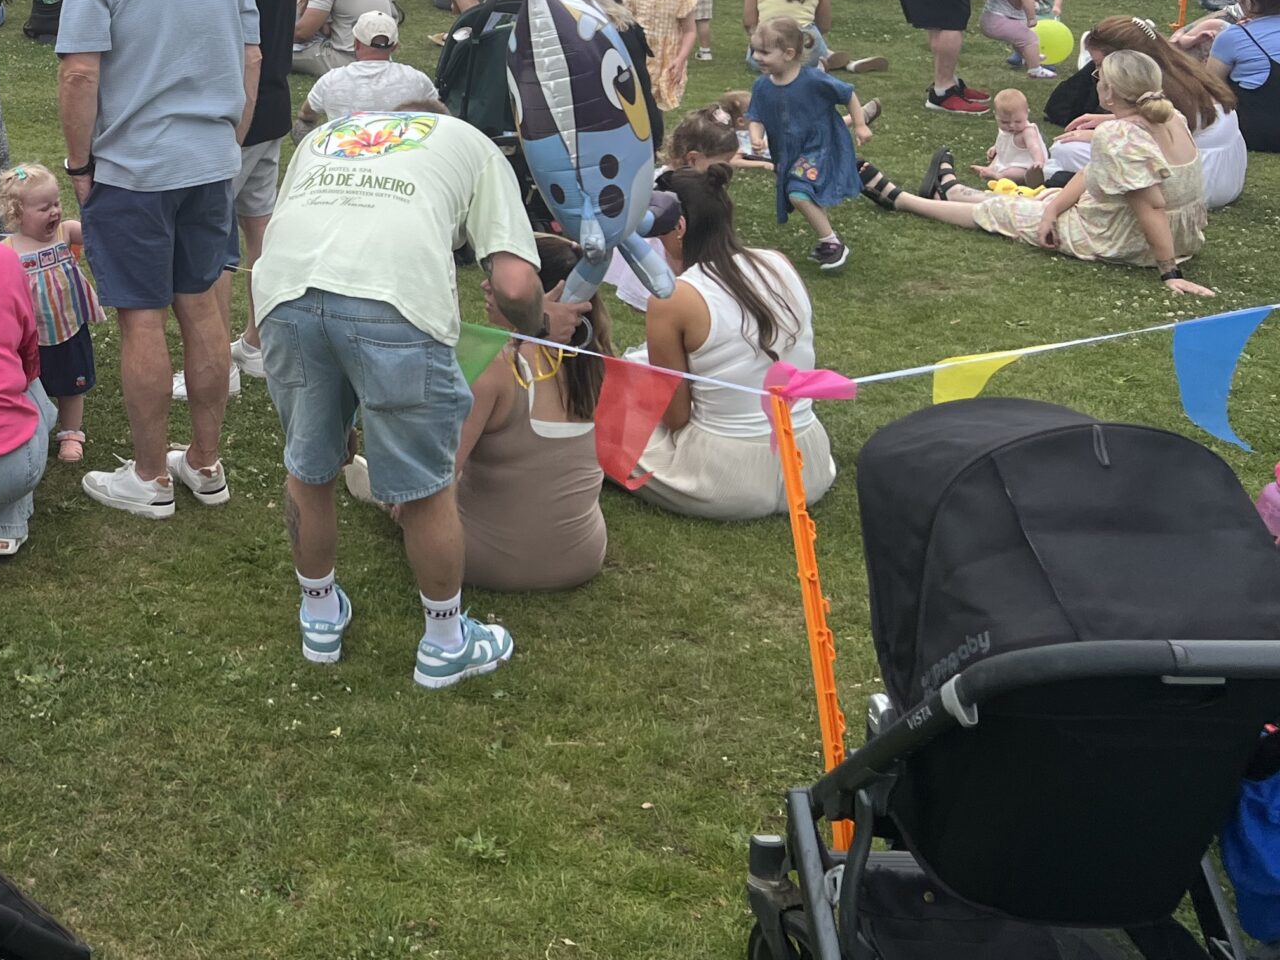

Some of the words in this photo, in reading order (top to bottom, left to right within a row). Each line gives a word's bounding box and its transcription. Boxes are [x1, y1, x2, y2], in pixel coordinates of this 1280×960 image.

[335, 174, 353, 187] DE
[355, 173, 416, 197] JANEIRO
[906, 705, 933, 730] VISTA
